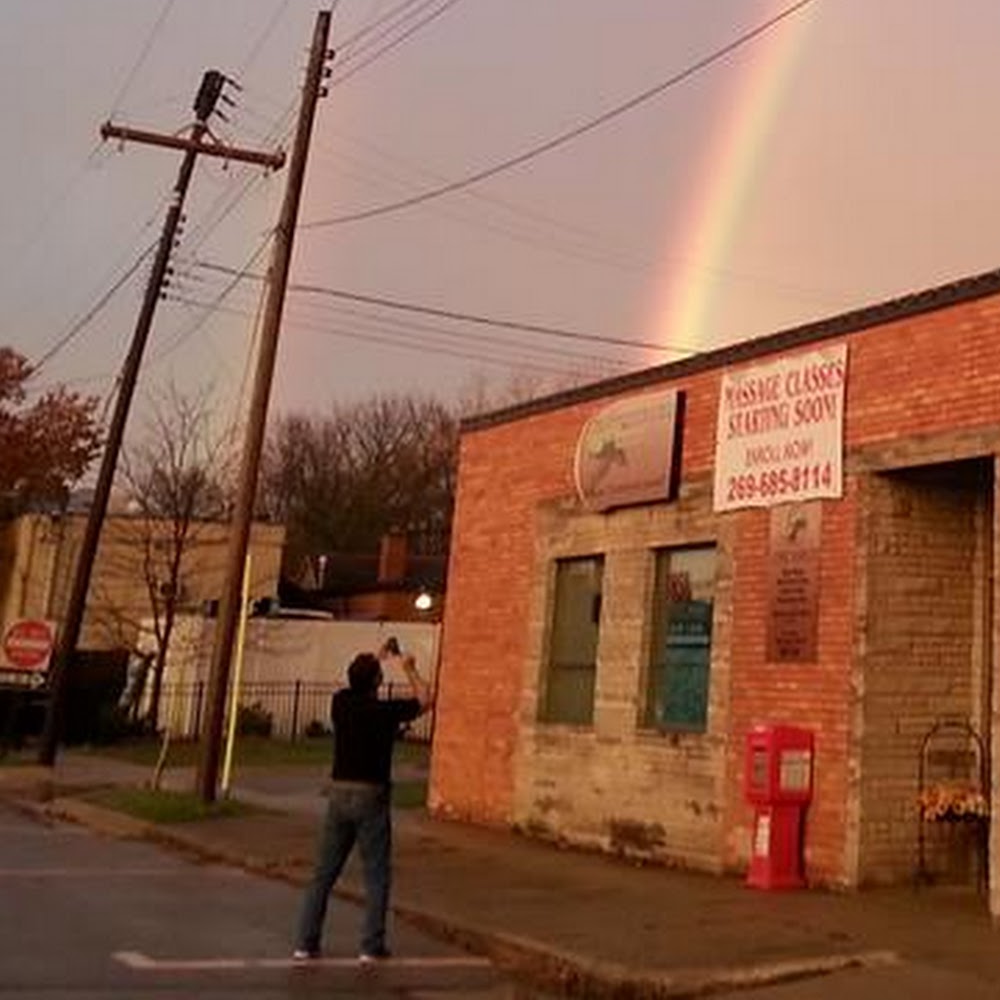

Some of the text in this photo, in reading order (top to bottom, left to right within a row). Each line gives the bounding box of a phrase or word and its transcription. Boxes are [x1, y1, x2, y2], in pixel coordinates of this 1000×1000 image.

[786, 358, 844, 398] CLASSES
[728, 402, 790, 439] STARTING
[727, 462, 832, 501] 269-685-8114
